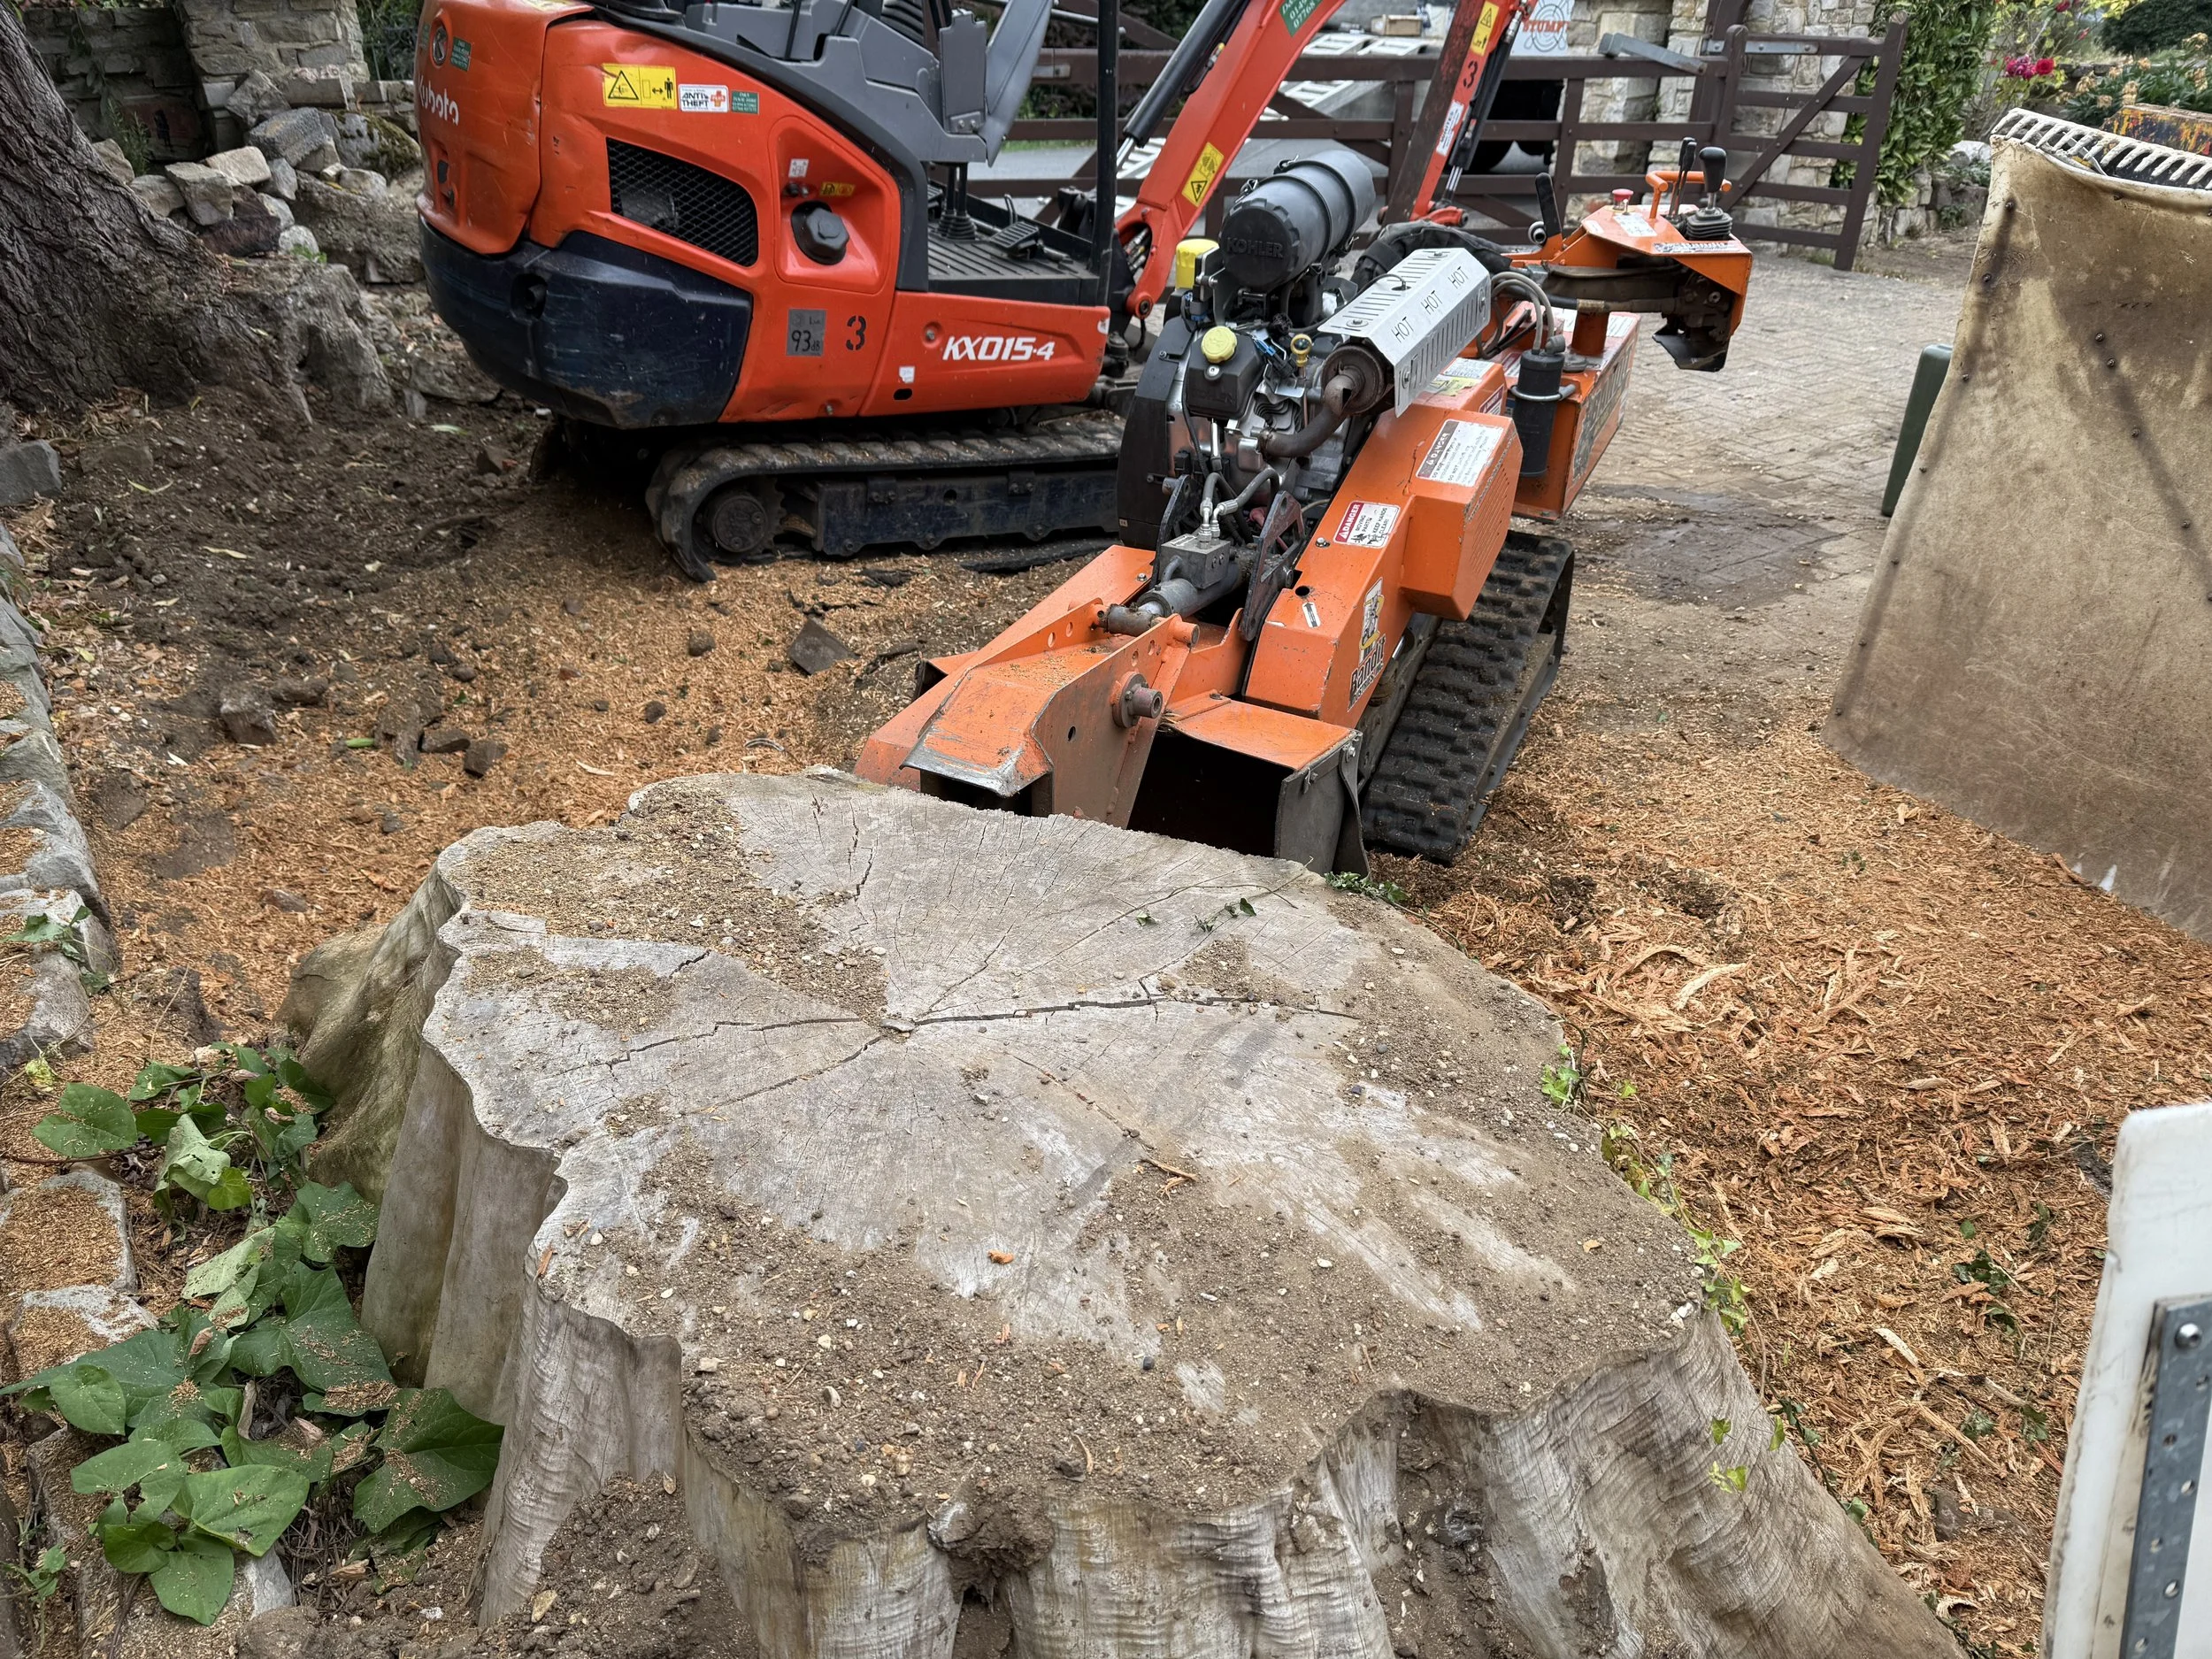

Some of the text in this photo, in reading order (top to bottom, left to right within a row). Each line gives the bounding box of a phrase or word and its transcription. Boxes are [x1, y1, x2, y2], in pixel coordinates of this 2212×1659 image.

[1463, 60, 1479, 88] 3
[418, 73, 459, 127] Kubota
[1227, 237, 1284, 259] KOHLER
[1448, 266, 1469, 289] HOT
[1420, 290, 1443, 315] HOT
[846, 315, 866, 350] 3
[1391, 317, 1414, 343] HOT
[942, 335, 1056, 361] KX015-4
[1342, 503, 1361, 533] DANGER
[1372, 522, 1381, 534] KEEP
